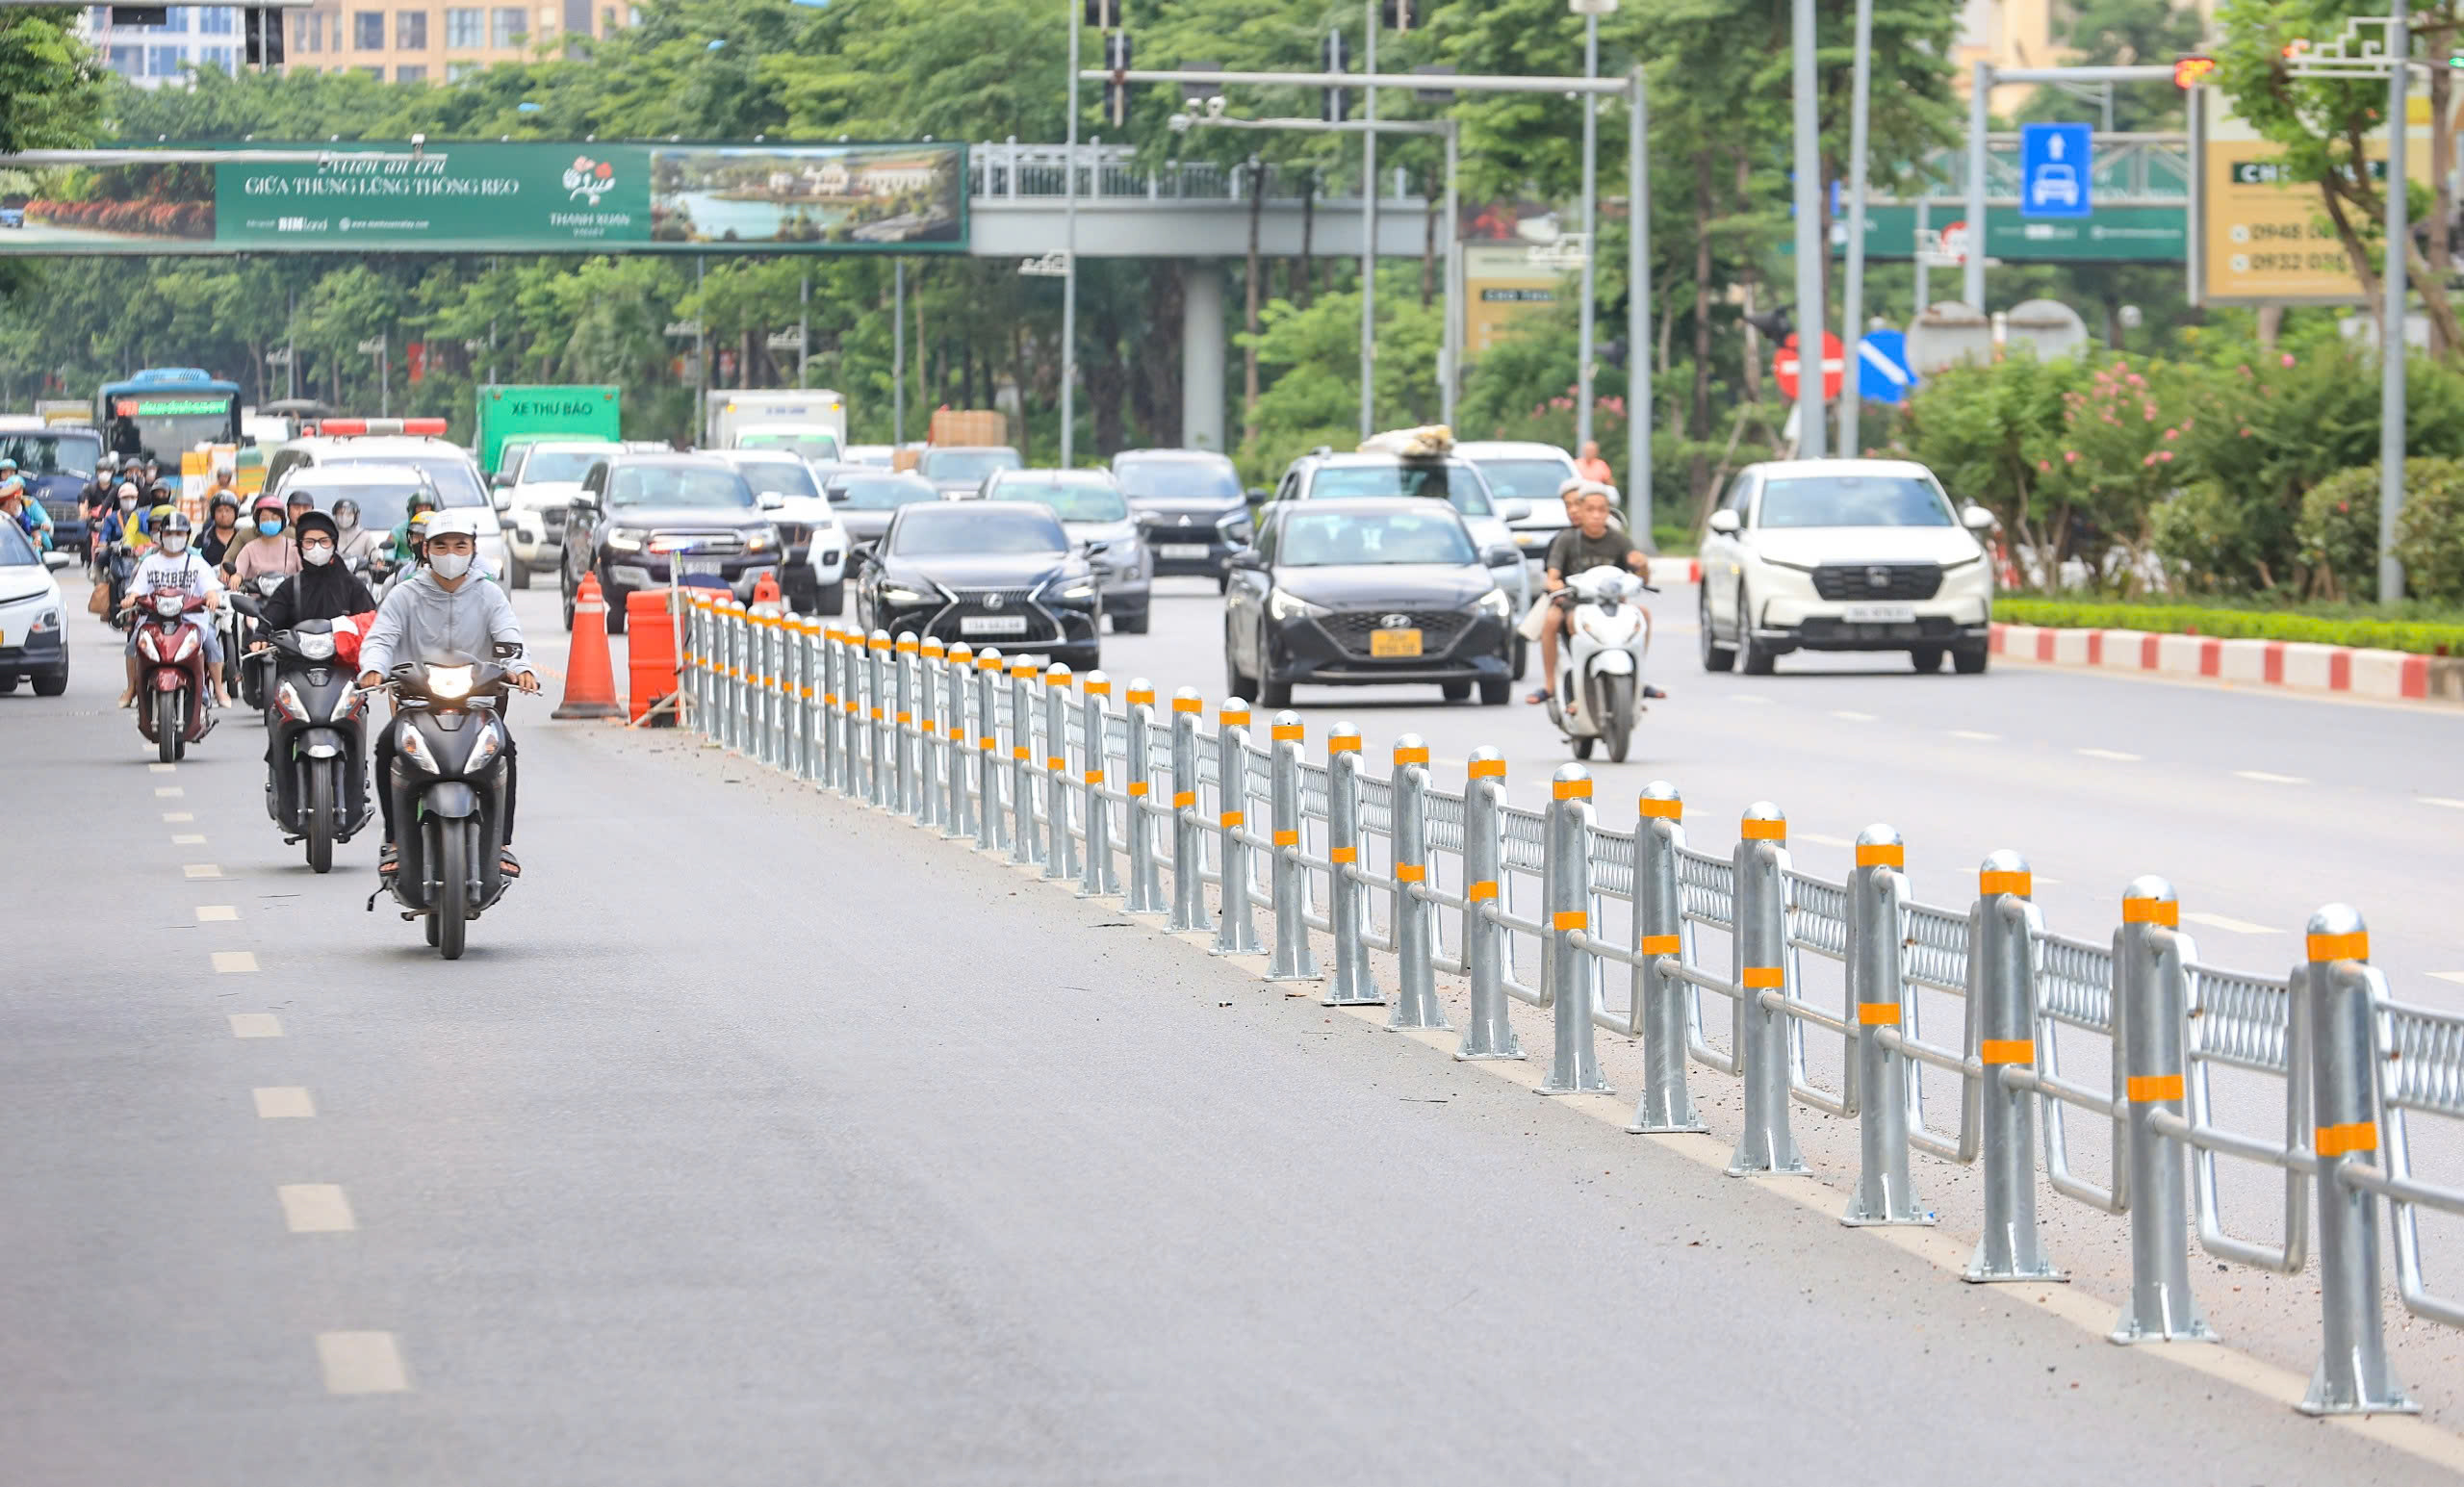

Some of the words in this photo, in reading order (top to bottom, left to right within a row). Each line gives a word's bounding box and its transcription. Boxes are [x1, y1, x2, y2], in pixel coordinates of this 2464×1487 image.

[245, 176, 289, 194] GIỮA
[293, 177, 356, 194] THUNG
[360, 176, 410, 194] LŨNG
[511, 400, 529, 416] XE
[147, 570, 198, 583] MEMBERS
